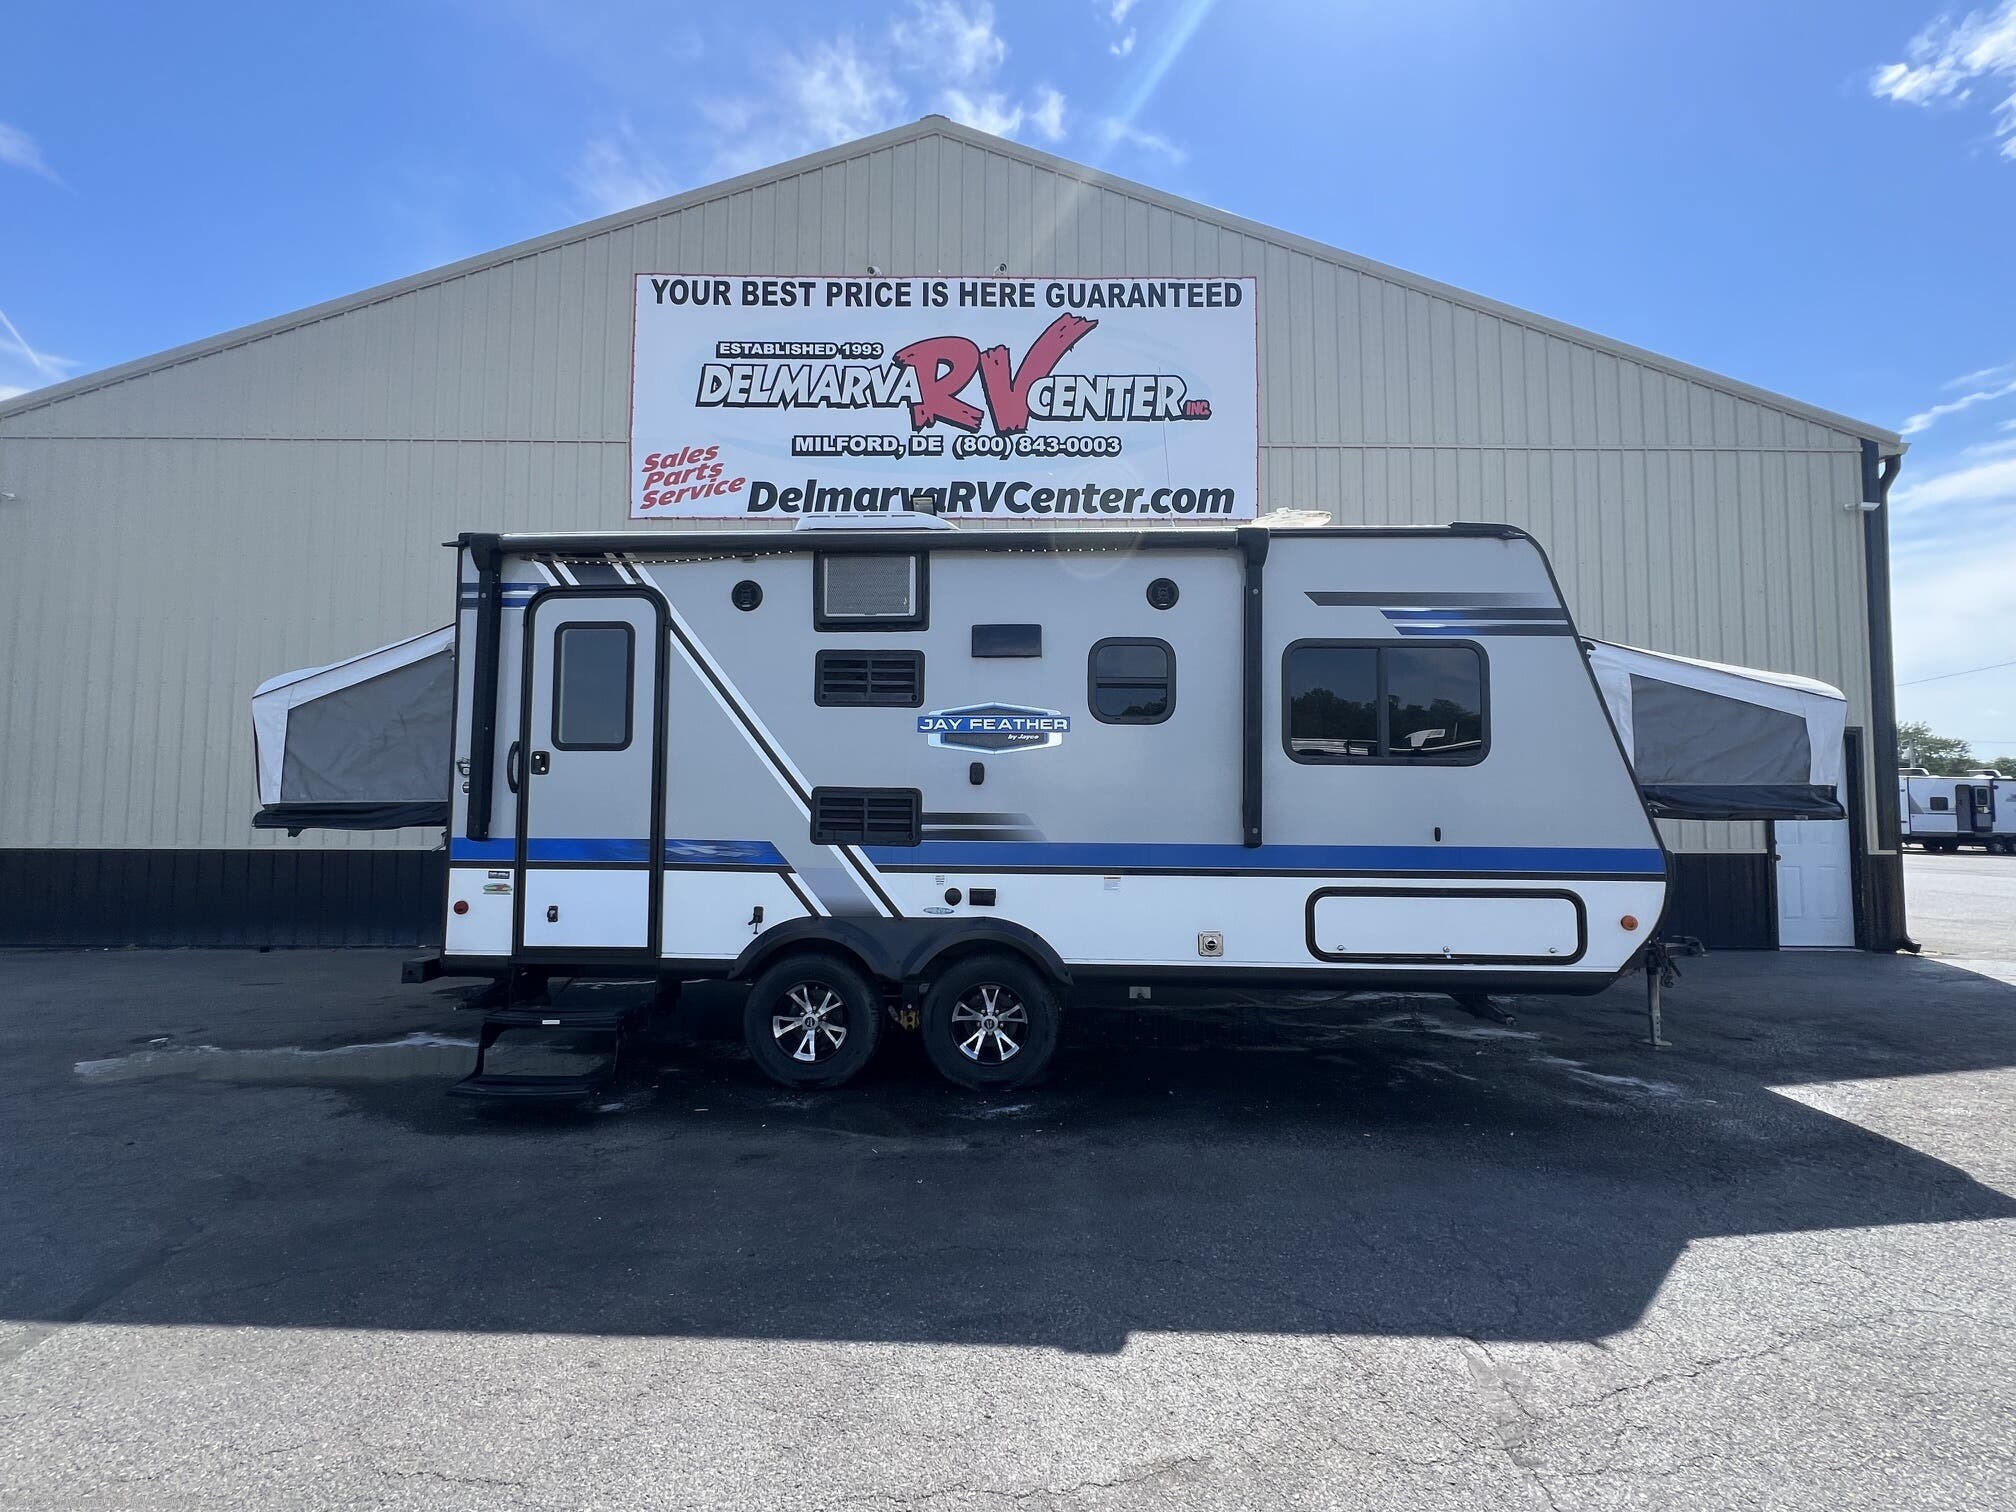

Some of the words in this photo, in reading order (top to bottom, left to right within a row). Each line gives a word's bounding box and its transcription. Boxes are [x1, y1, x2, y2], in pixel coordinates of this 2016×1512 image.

[651, 279, 732, 306] YOUR
[741, 281, 816, 307] BEST
[826, 281, 912, 308] PRICE
[921, 282, 949, 308] IS
[959, 282, 1036, 308] HERE
[1045, 282, 1243, 309] GUARANTEED
[717, 341, 838, 357] ESTABLISHED
[841, 342, 884, 357] 1993
[697, 363, 924, 409] DELMARVA
[892, 312, 1099, 435] RV
[1026, 375, 1187, 420] CENTER
[641, 445, 721, 473] Sales
[793, 435, 904, 459] MILFORD,
[909, 435, 944, 455] DE
[953, 435, 1012, 459] (800)
[1016, 435, 1122, 456] 843-0003
[642, 461, 725, 492] Parts
[639, 475, 747, 510] Service
[919, 718, 963, 731] JAY
[969, 718, 1069, 731] FEATHER
[1007, 732, 1017, 741] by
